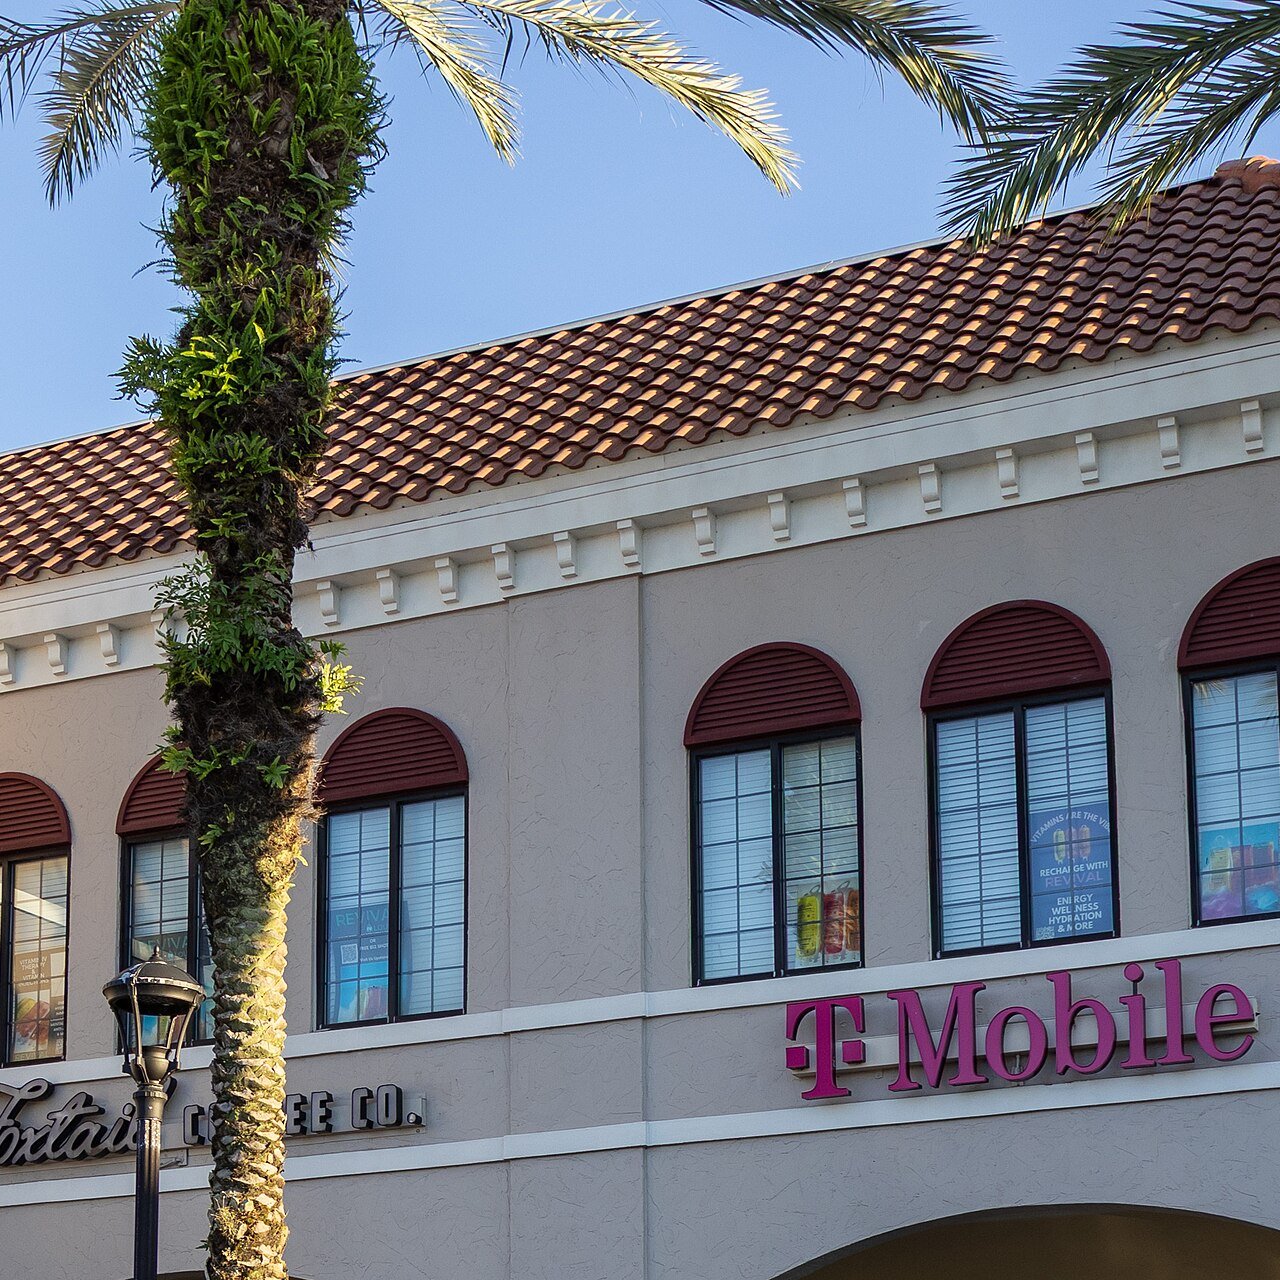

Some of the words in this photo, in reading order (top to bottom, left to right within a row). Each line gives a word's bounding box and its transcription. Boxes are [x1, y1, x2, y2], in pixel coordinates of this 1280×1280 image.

[1031, 814, 1065, 843] VITAMINS
[1084, 812, 1098, 822] THE
[1099, 818, 1110, 832] VIB
[1086, 861, 1108, 871] WITH
[1052, 902, 1098, 915] WELNESS
[336, 908, 388, 927] REVIVA
[1058, 923, 1065, 932] &
[183, 1090, 334, 1145] CEE
[352, 1084, 423, 1129] CO.
